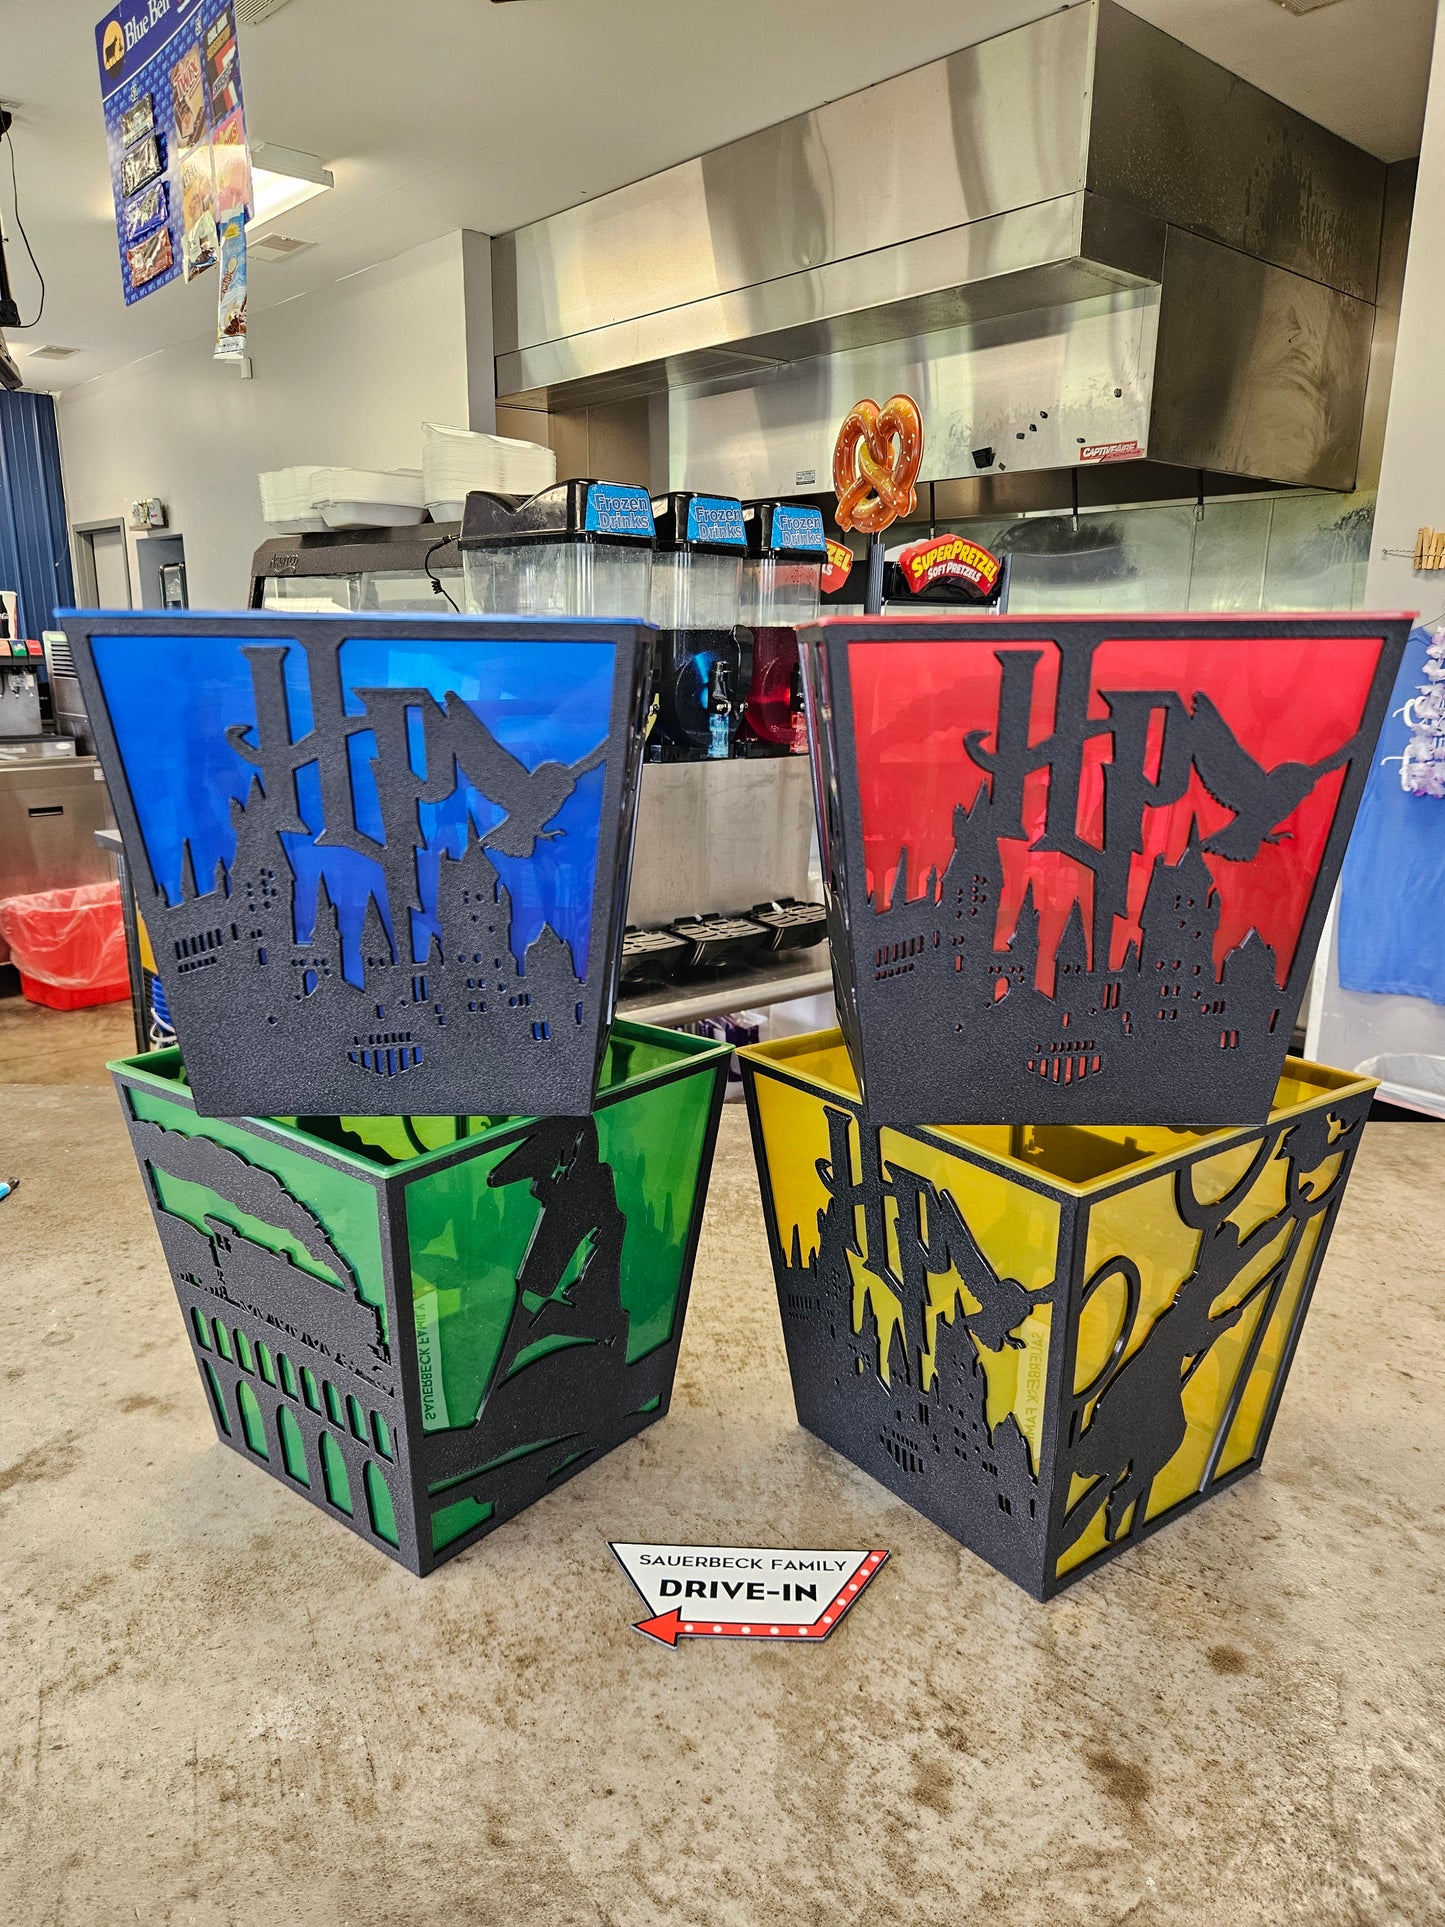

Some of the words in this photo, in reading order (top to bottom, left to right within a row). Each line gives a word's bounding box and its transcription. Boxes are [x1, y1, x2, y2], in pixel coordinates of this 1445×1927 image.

[123, 16, 150, 52] Blue
[593, 493, 649, 512] Frozen
[598, 512, 650, 529] Drinks
[694, 506, 741, 522] Frozen
[779, 514, 821, 531] Frozen
[698, 523, 743, 540] Drinks
[782, 530, 823, 547] Drinks
[927, 564, 947, 581] SOFT
[945, 561, 982, 583] PRETZELS
[639, 1554, 763, 1570] SAUERBECK
[771, 1559, 847, 1572] FAMILY
[659, 1579, 818, 1602] DRIVE-IN
